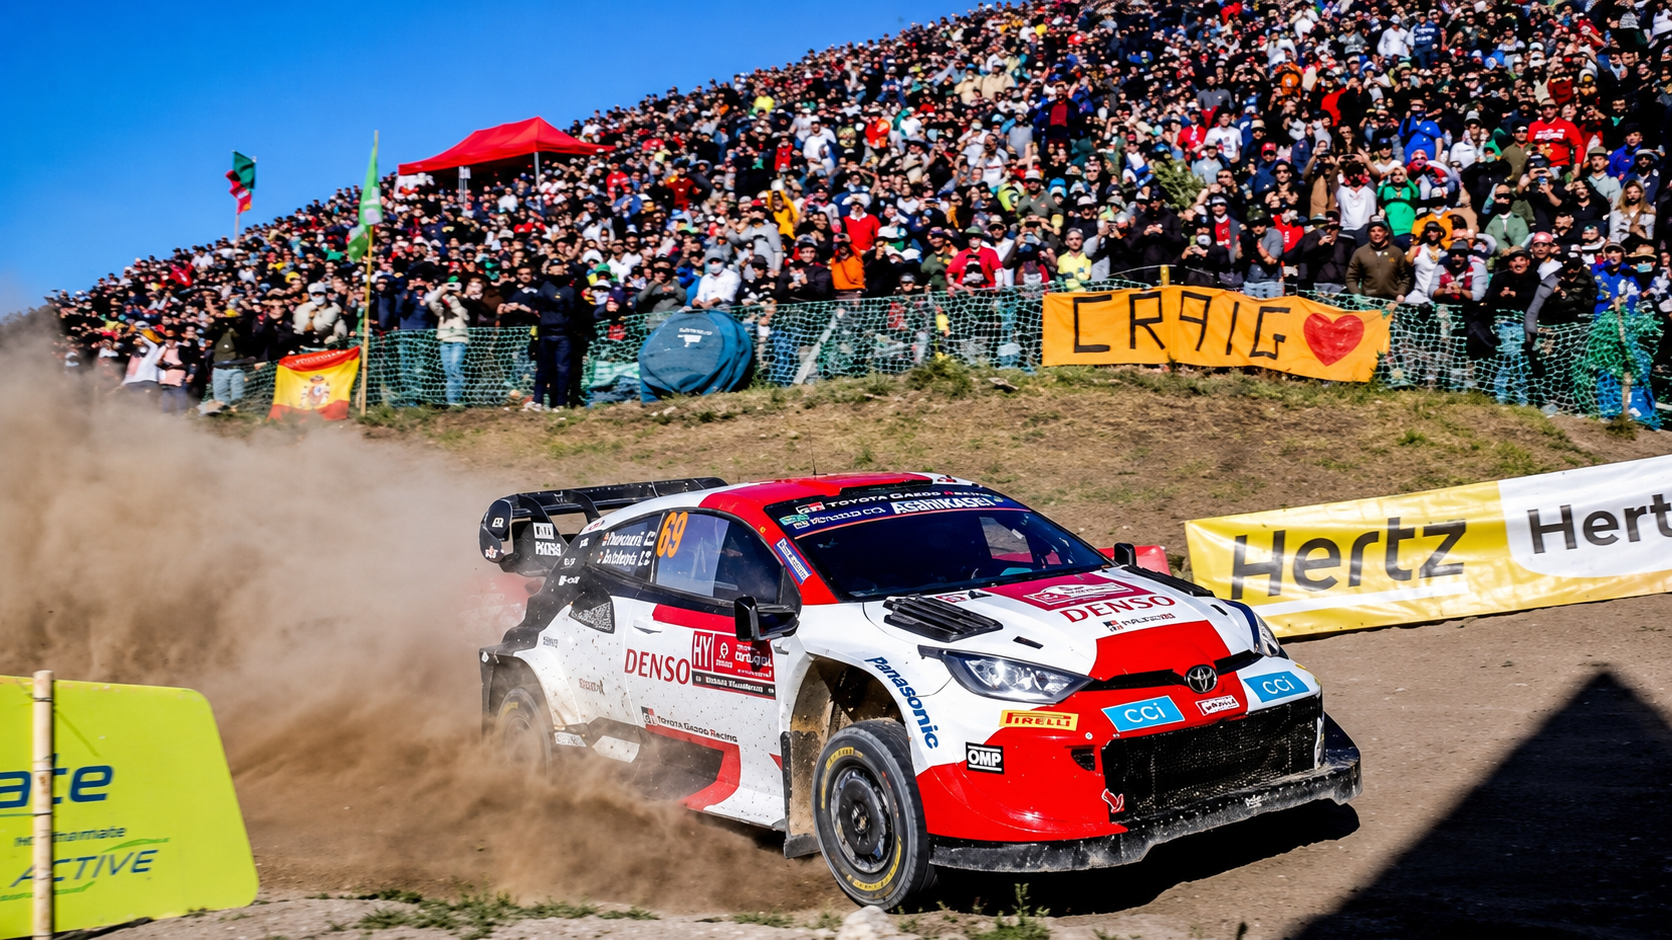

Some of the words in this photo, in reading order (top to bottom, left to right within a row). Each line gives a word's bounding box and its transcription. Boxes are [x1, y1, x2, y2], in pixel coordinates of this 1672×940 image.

[1073, 290, 1291, 360] CRAIG
[825, 495, 888, 508] TOYOTA
[656, 511, 689, 558] 69
[1527, 494, 1672, 554] Hert
[1230, 516, 1467, 600] Hertz
[1059, 595, 1176, 623] DENSO
[624, 648, 691, 685] DENSO
[693, 634, 712, 668] HY
[864, 656, 939, 750] Panasonic
[1005, 712, 1072, 727] PIRELLI
[967, 749, 1002, 767] OMP
